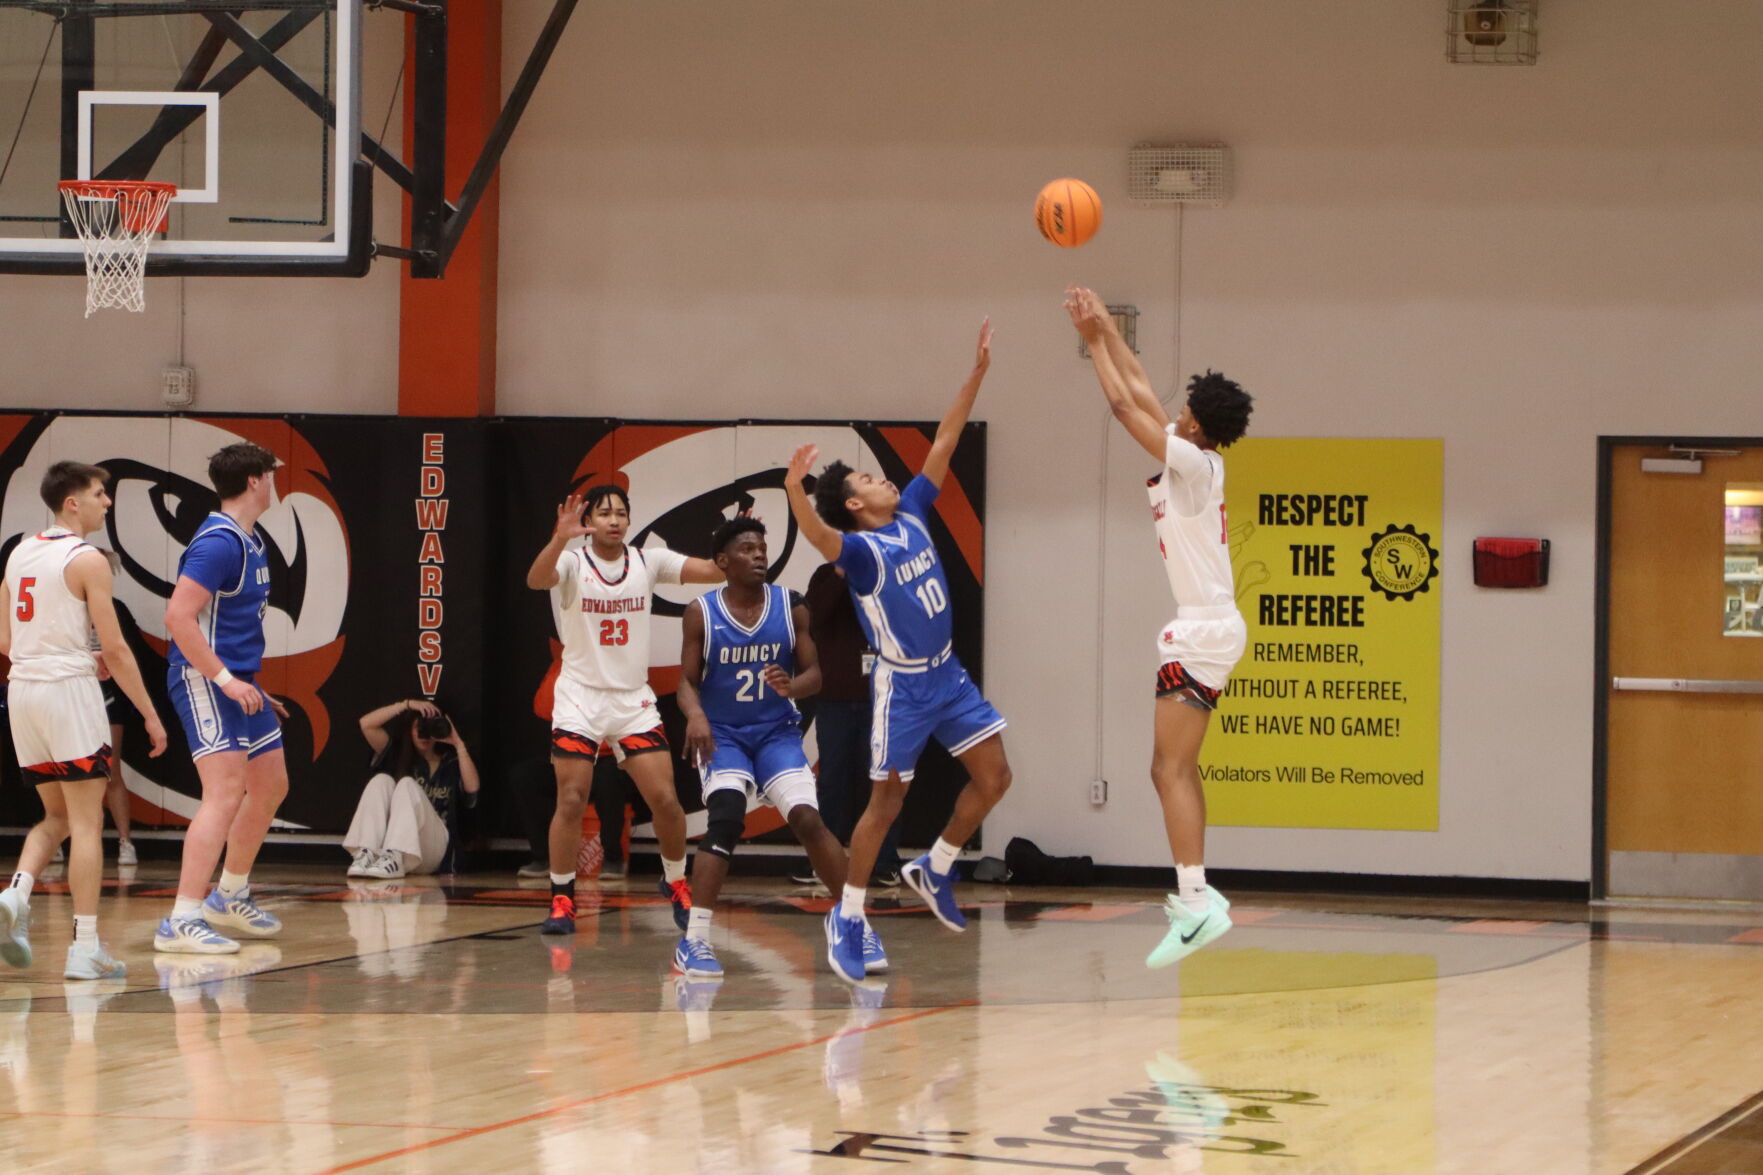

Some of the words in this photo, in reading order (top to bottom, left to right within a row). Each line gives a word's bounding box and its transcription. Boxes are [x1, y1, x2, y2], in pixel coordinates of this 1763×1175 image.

[1258, 493, 1369, 527] RESPECT
[1374, 535, 1427, 559] SOUTHWESTERN
[415, 433, 449, 699] EDWARDSV
[1289, 544, 1336, 577] THE
[1375, 570, 1425, 591] CONFERENCE
[16, 576, 37, 623] 5
[581, 595, 645, 615] EDWARDSVILLE
[916, 577, 947, 620] 10
[1259, 594, 1365, 627] REFEREE
[599, 618, 629, 646] 23
[719, 642, 781, 665] QUINCY
[1253, 642, 1364, 667] REMEMBER,
[735, 669, 766, 702] 21
[1304, 680, 1317, 699] A
[1322, 680, 1407, 704] REFEREE,
[1220, 714, 1250, 734] WE
[1255, 715, 1304, 736] HAVE
[1309, 716, 1336, 736] NO
[1341, 717, 1401, 738] GAME!
[1198, 764, 1271, 783] Violators
[1275, 766, 1306, 783] Will
[1311, 767, 1335, 784] Be
[1340, 768, 1425, 786] Removed
